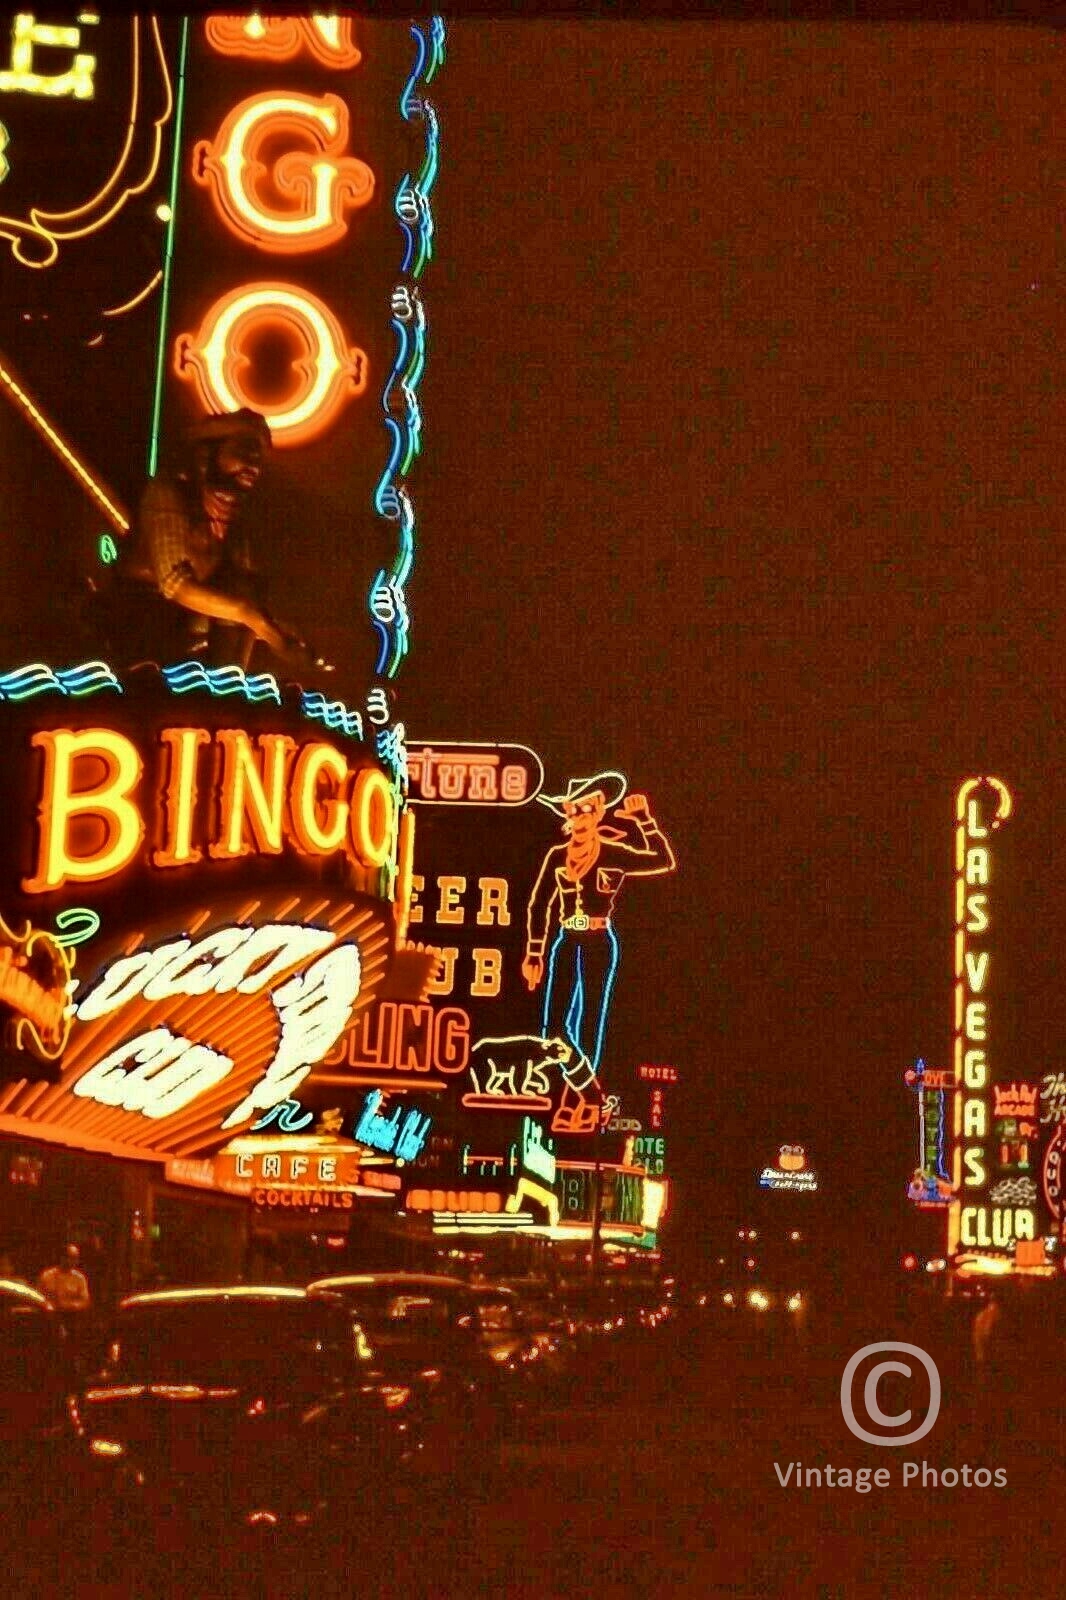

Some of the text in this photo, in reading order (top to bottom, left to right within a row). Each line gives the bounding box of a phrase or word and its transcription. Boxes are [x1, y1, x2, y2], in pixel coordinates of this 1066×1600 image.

[22, 727, 396, 893] BINGO
[963, 799, 990, 1187] LAS VEGAS
[235, 1154, 338, 1182] CAFE
[255, 1190, 353, 1209] COCKTAILS
